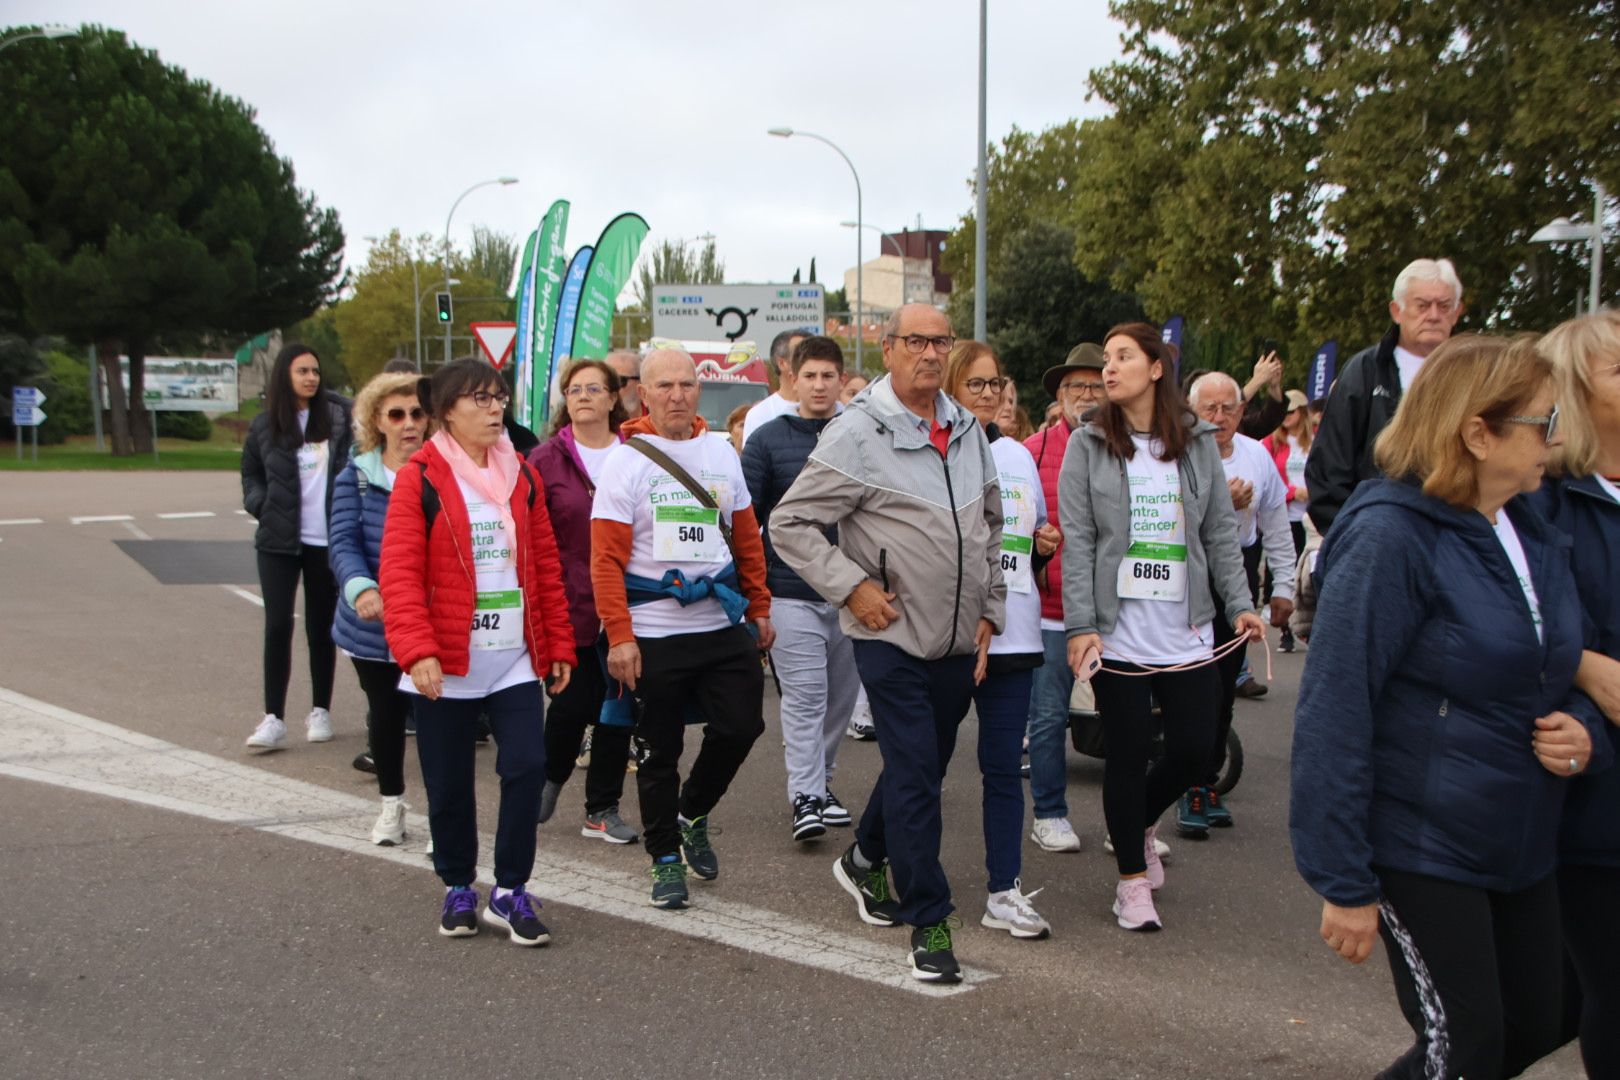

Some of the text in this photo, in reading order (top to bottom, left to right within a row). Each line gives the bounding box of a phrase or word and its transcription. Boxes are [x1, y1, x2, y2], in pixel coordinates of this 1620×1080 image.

[538, 281, 552, 331] Corte
[771, 302, 817, 310] PORTUGAL
[650, 492, 668, 504] En
[1136, 491, 1184, 504] marcha
[1133, 519, 1177, 531] cáncer
[679, 526, 704, 543] 540
[1001, 554, 1018, 572] 64
[1133, 561, 1170, 581] 6865
[471, 613, 500, 631] 542
